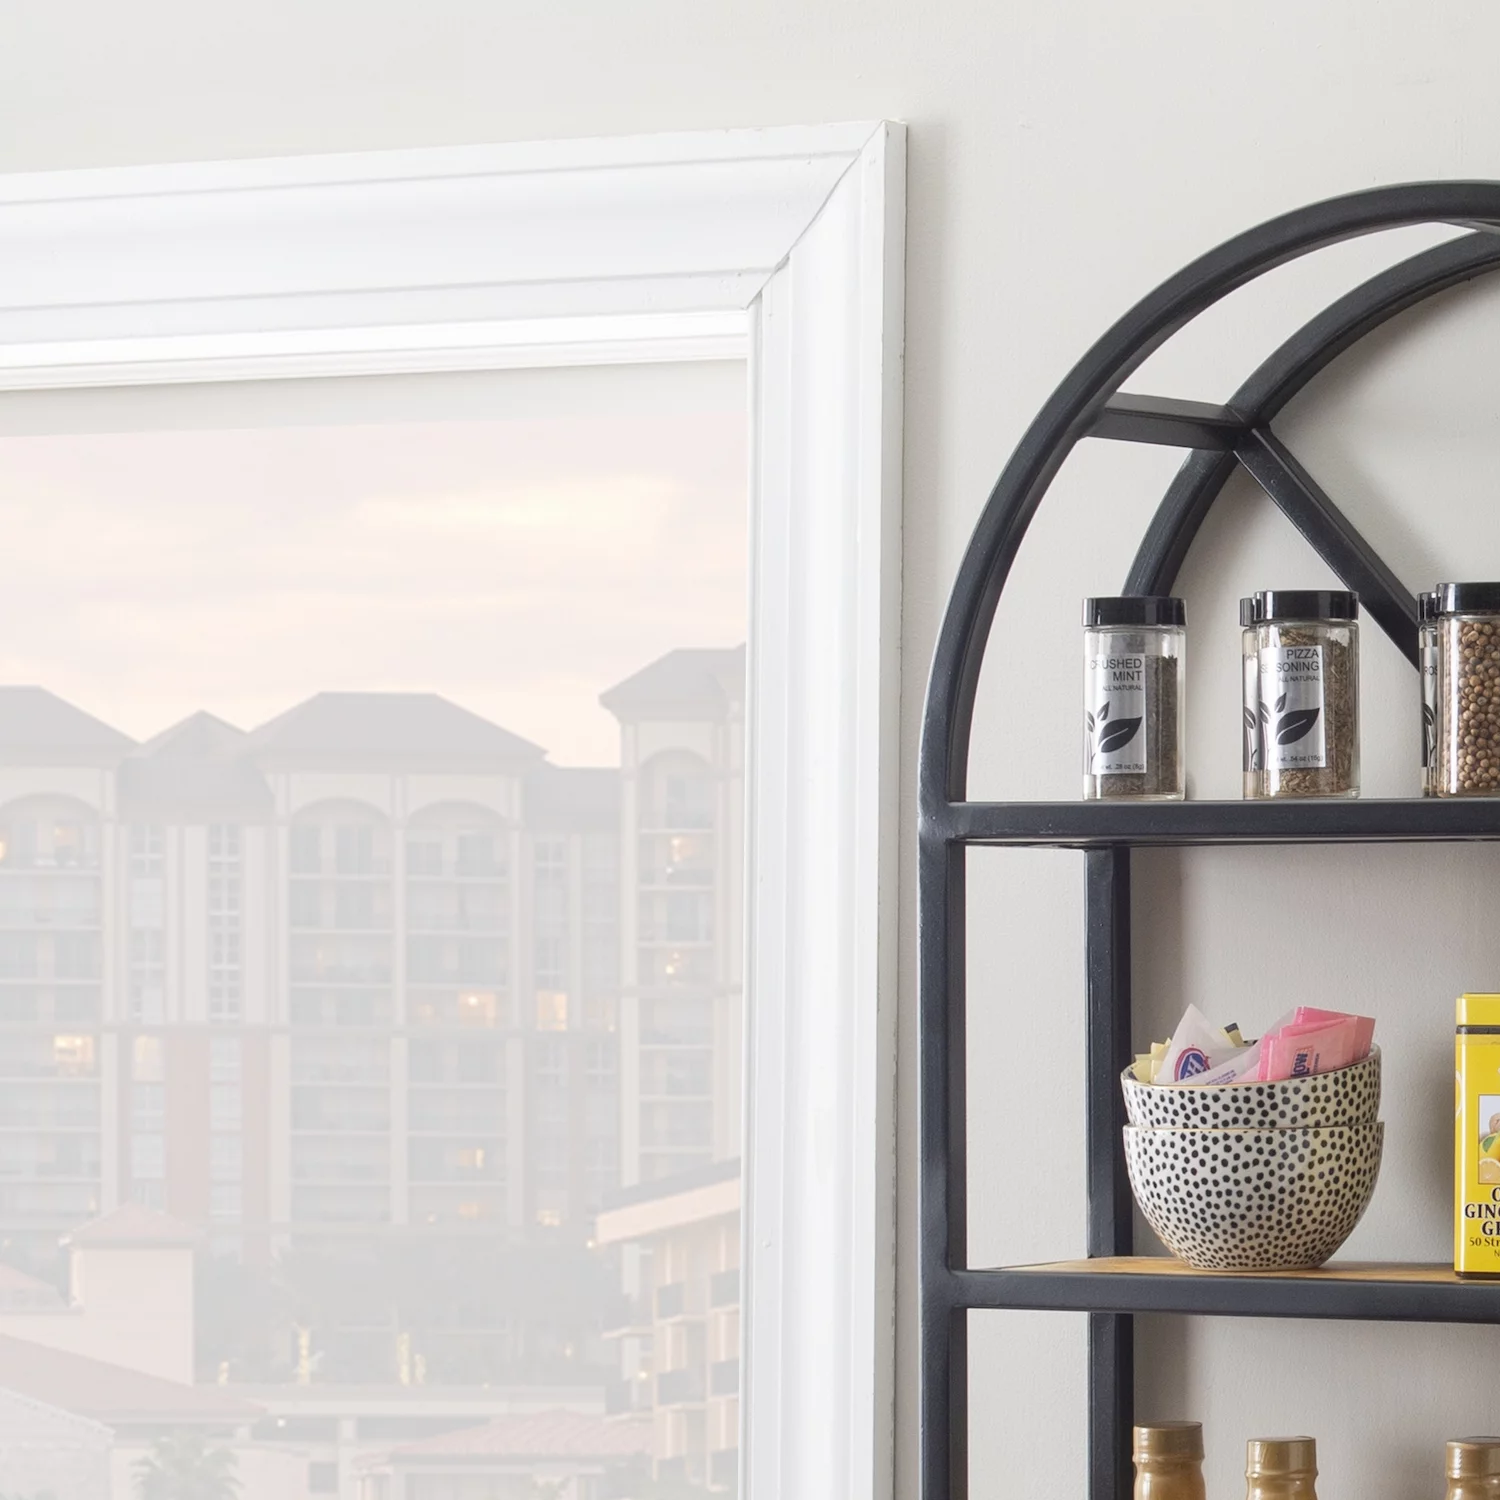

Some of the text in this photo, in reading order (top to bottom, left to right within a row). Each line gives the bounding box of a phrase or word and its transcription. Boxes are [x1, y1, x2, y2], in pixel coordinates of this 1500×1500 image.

[1286, 648, 1319, 659] PIZZA
[1112, 670, 1142, 681] MINT
[1469, 1237, 1482, 1247] 50
